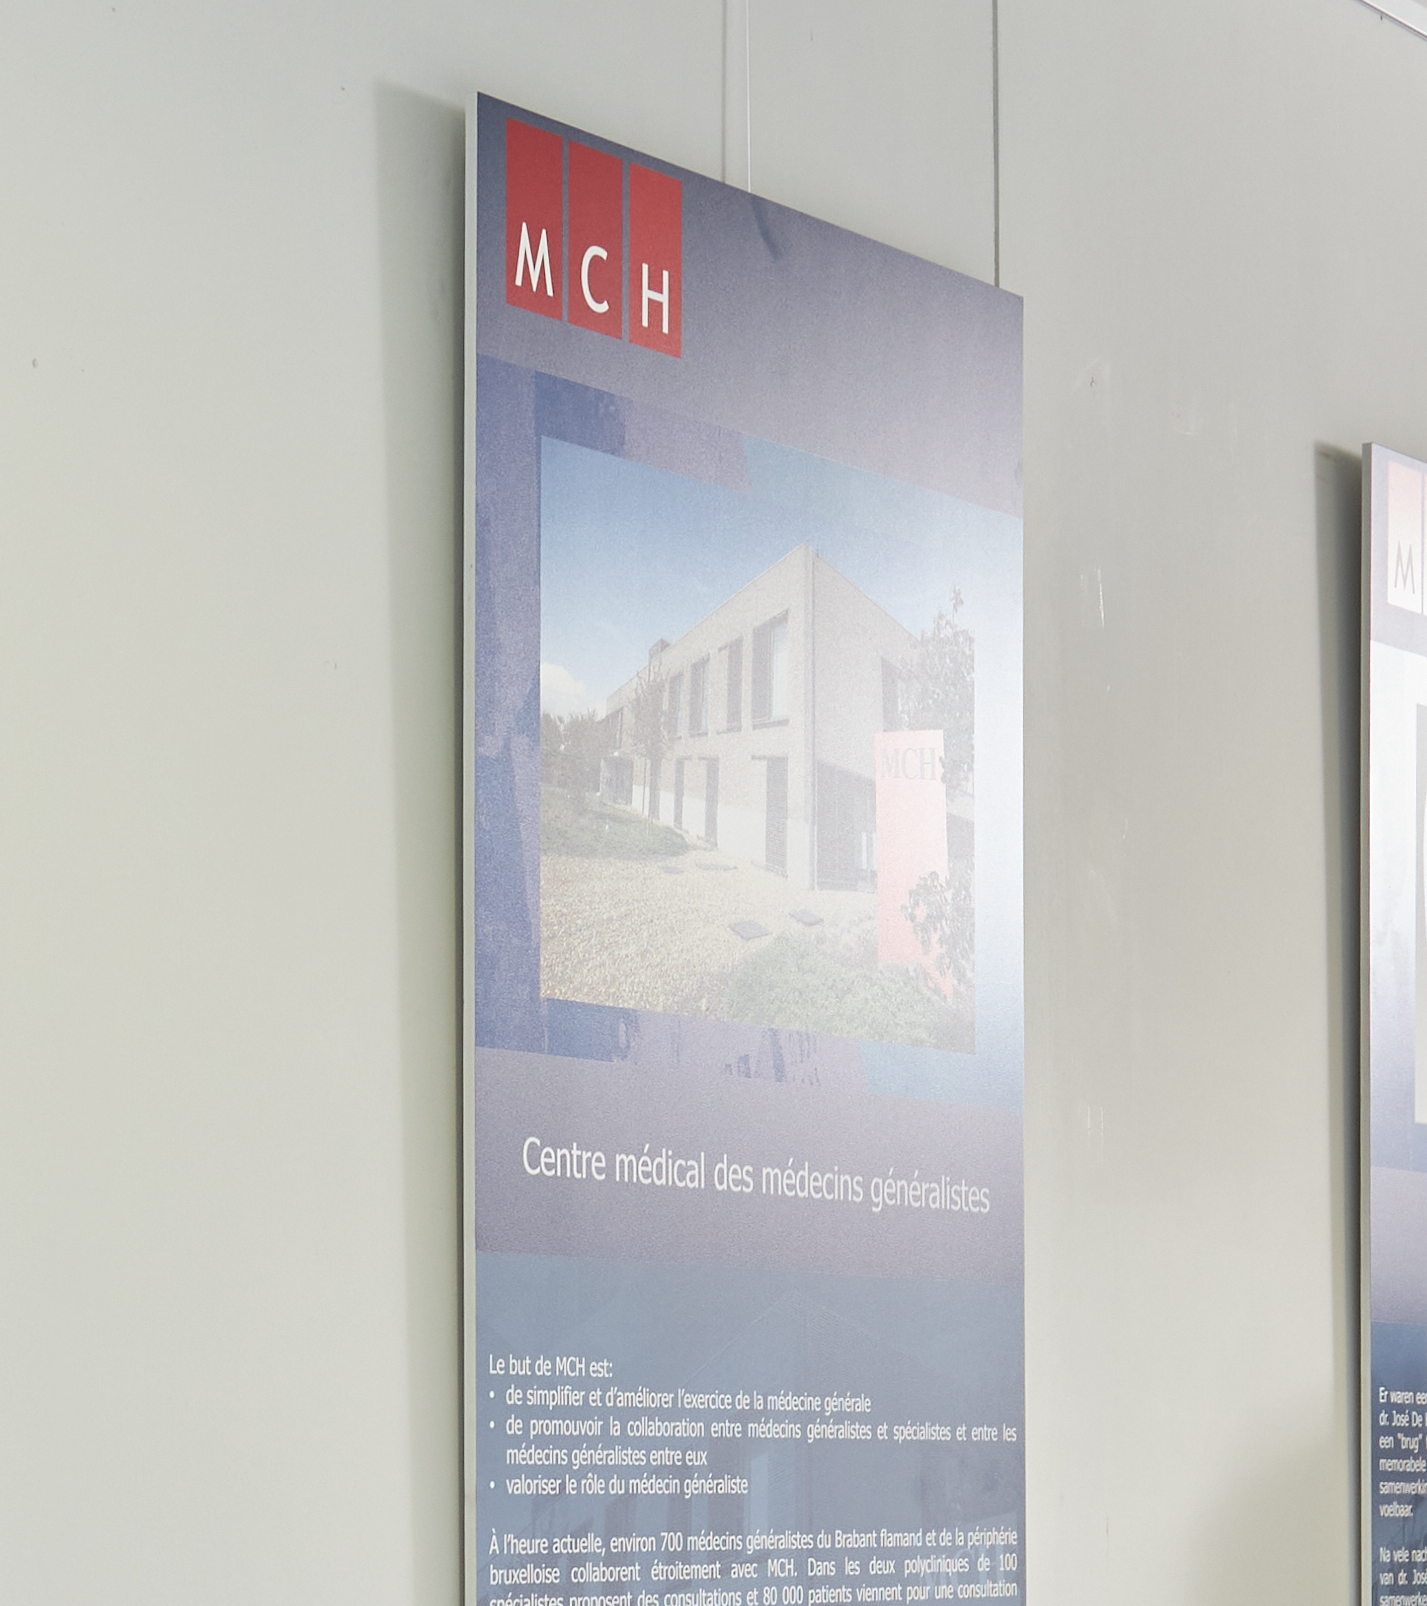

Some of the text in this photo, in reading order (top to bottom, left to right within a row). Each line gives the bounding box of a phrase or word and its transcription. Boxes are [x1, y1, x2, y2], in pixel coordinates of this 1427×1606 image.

[515, 222, 668, 334] MCH
[880, 747, 938, 781] MCH
[522, 1136, 989, 1213] Centre médical des médecins généralistes
[489, 1353, 612, 1377] Le but de MCH est:
[505, 1383, 871, 1416] de simplifier et d’améliorer l’exercice de la médecine générale
[506, 1442, 707, 1470] médecins généralistes entre eux
[1379, 1500, 1414, 1517] voelbaar.
